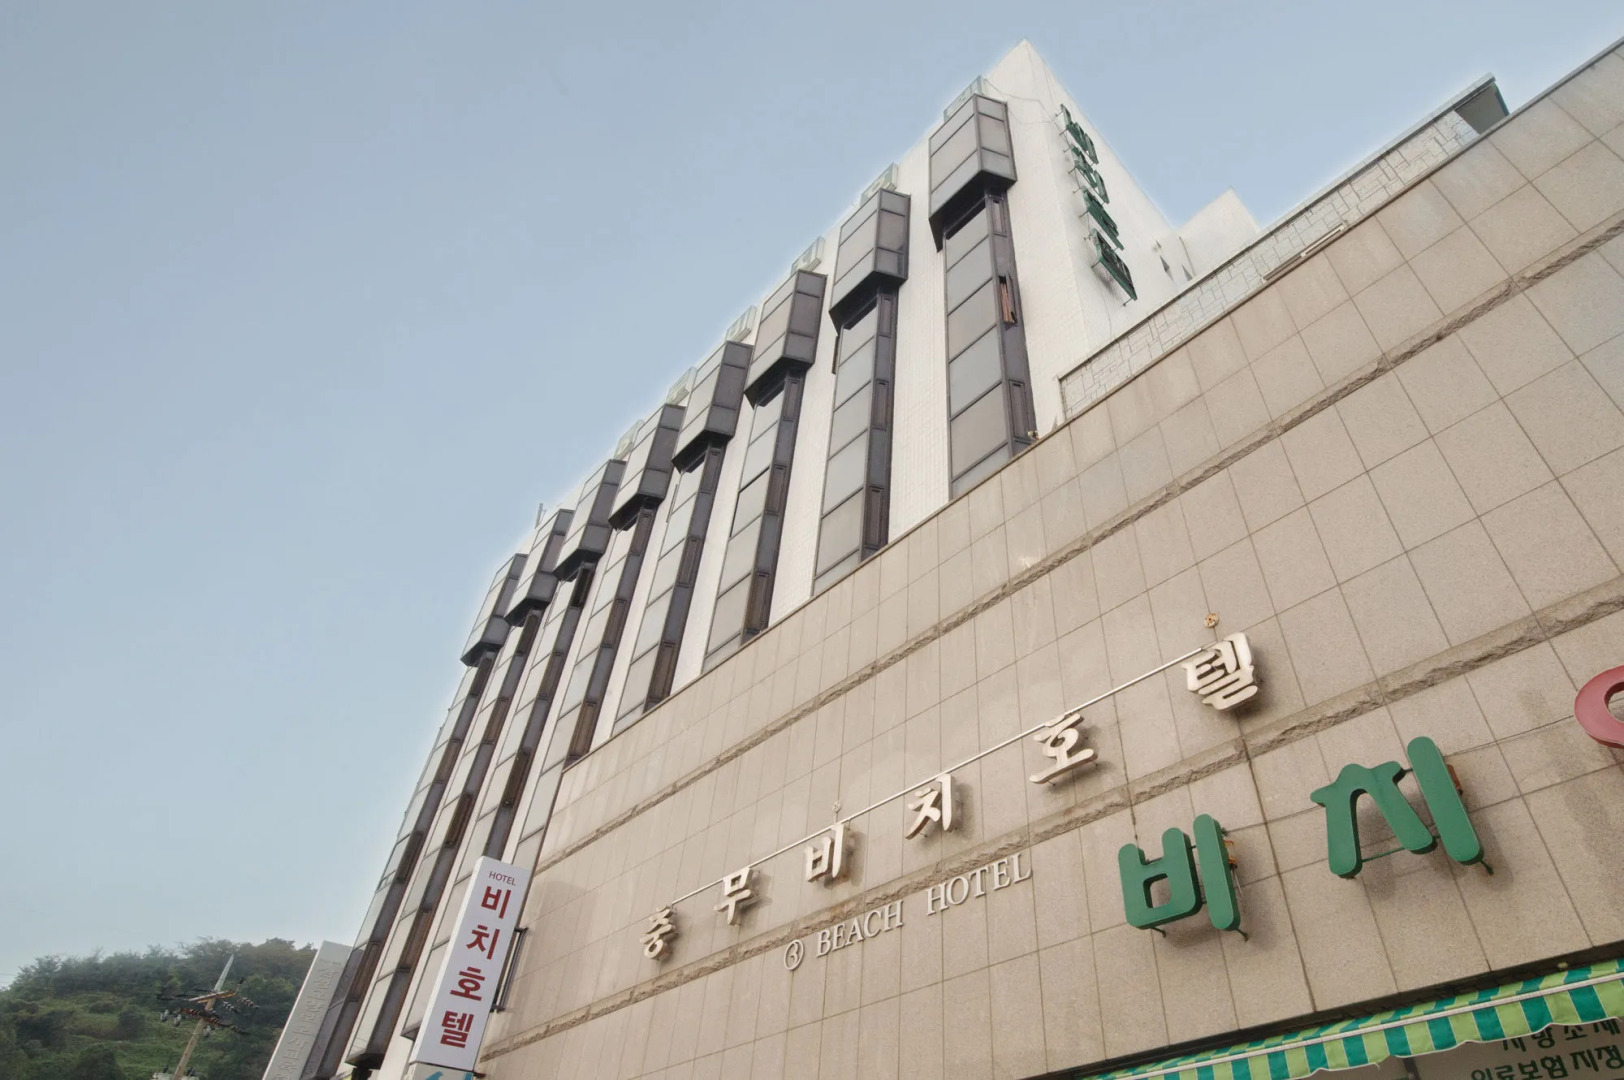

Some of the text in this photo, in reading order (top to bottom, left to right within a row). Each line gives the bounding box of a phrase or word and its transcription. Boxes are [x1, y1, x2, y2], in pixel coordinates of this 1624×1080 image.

[488, 870, 516, 886] HOTEL
[816, 900, 905, 958] BEACH
[926, 852, 1033, 916] HOTEL
[440, 886, 512, 1049] 비치호텔
